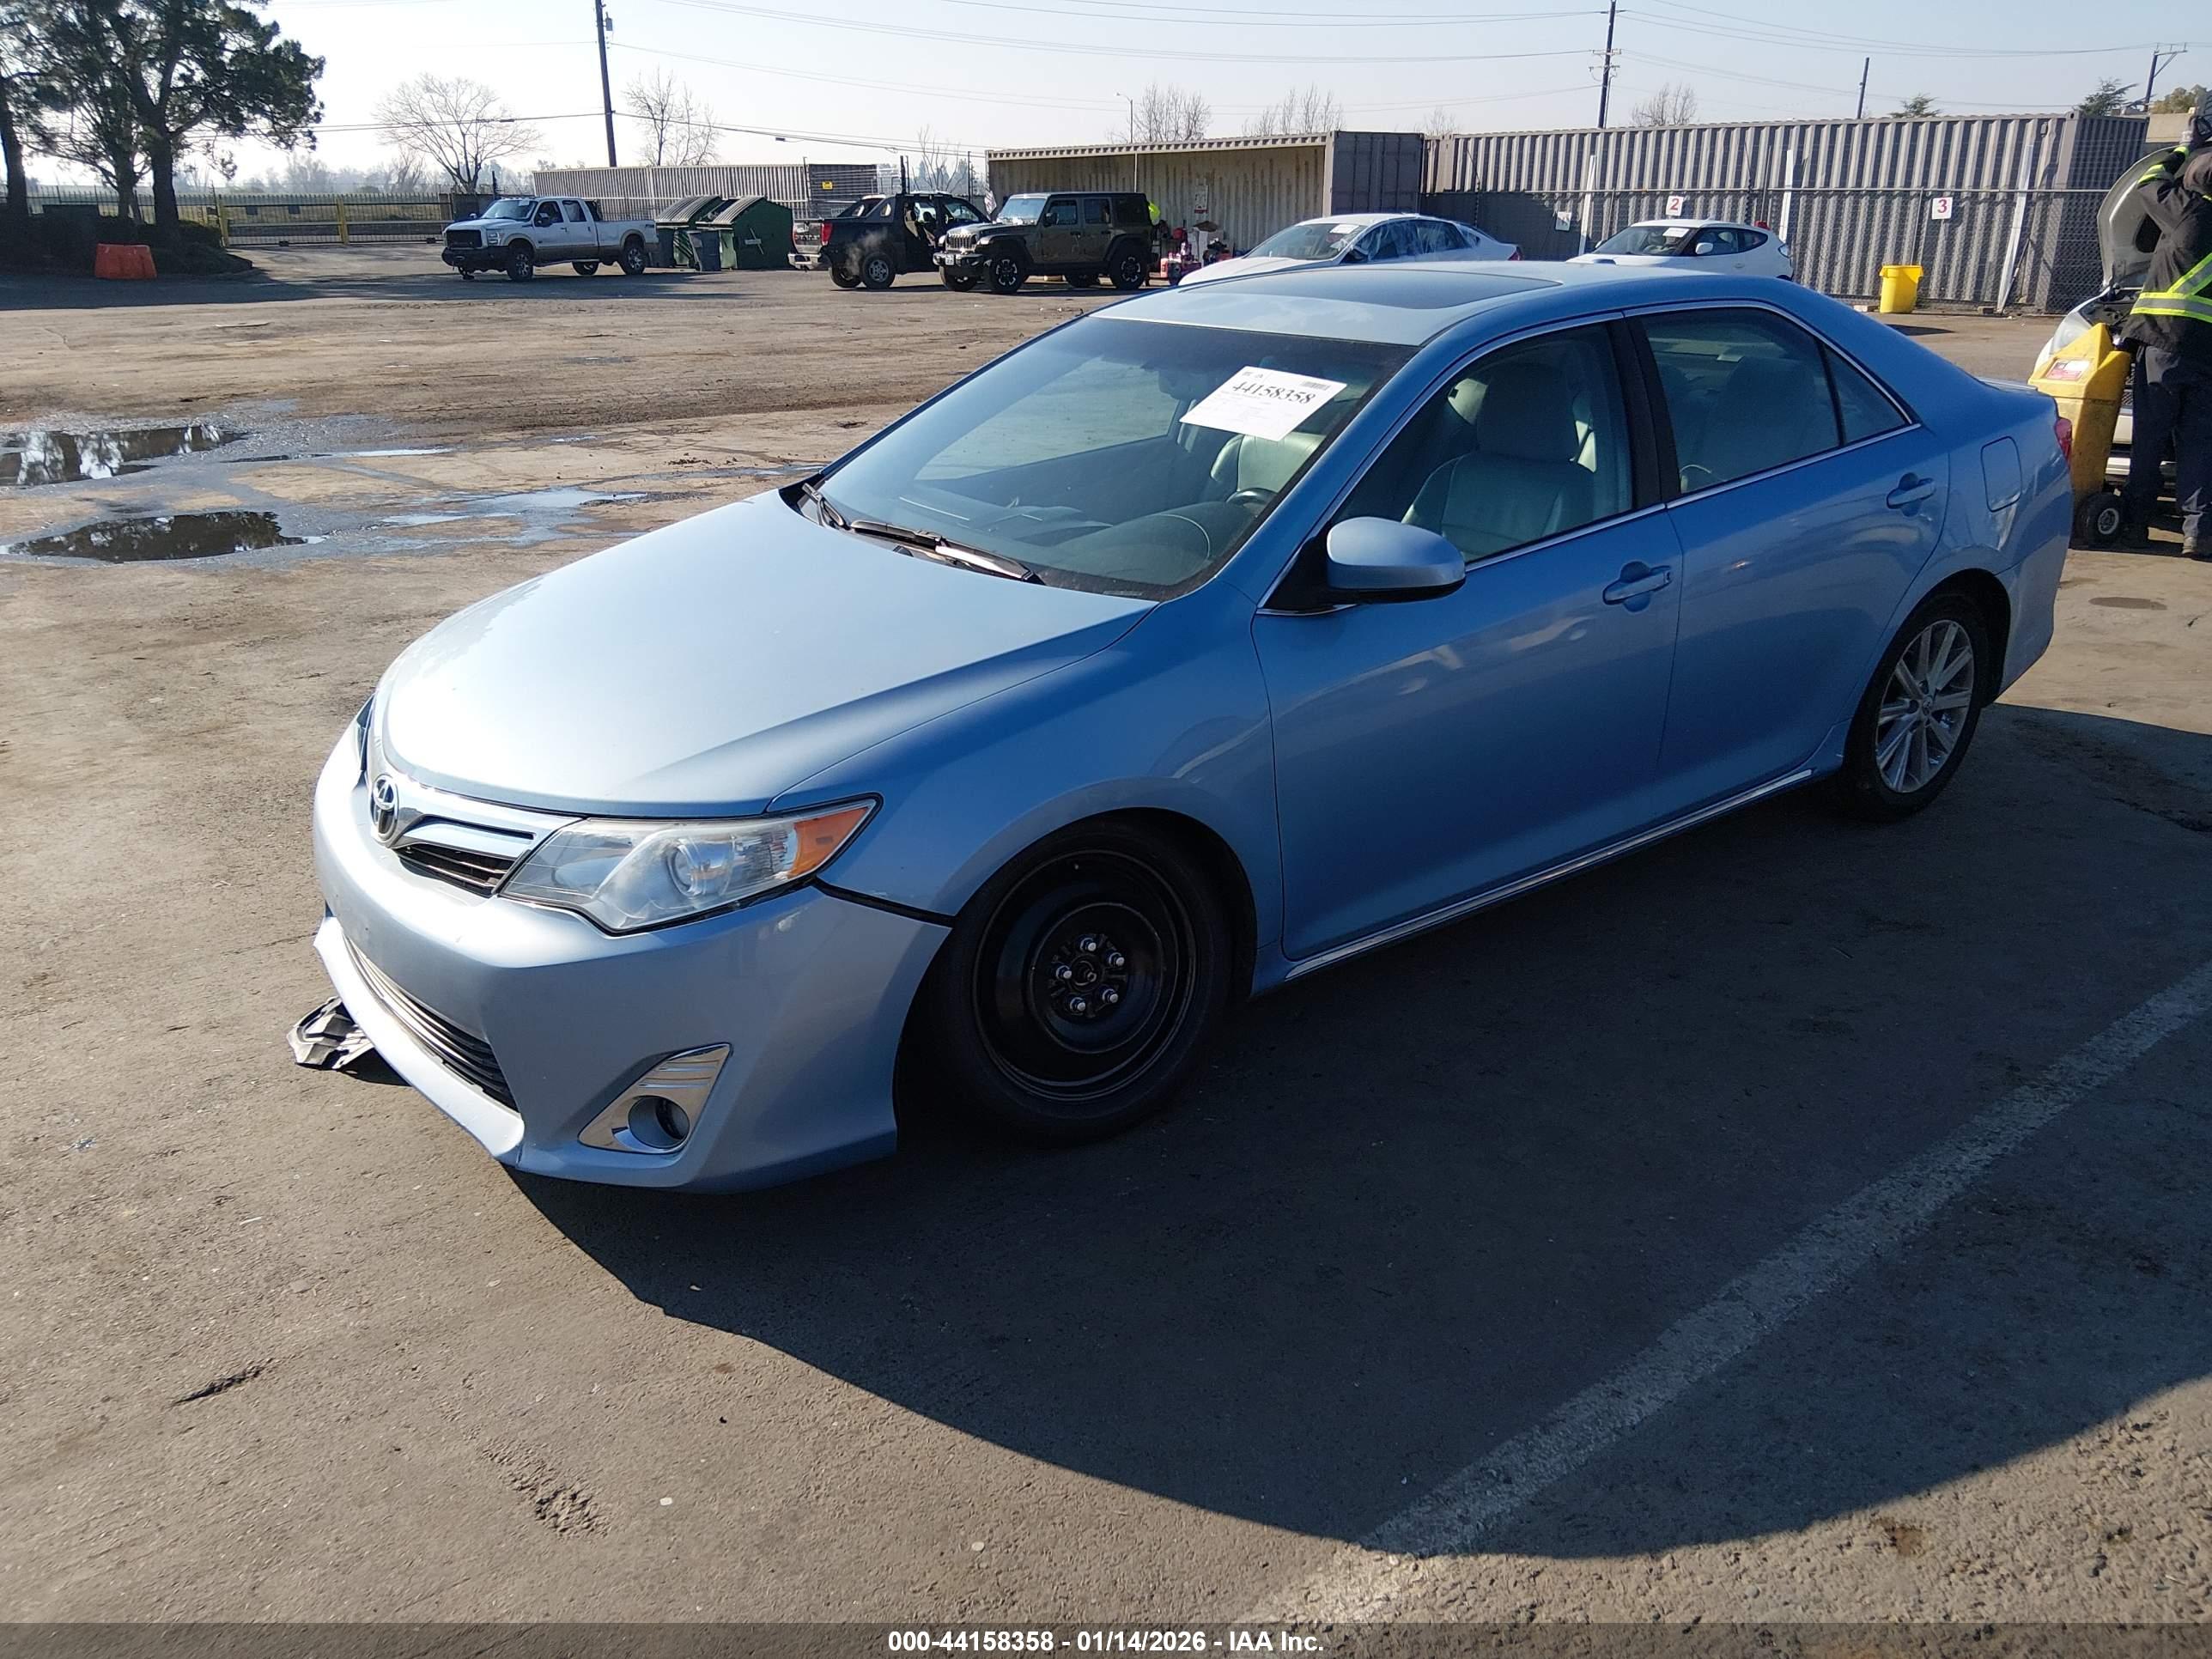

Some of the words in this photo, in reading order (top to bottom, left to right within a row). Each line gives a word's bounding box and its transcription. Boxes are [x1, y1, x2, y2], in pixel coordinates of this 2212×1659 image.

[1670, 198, 1680, 210] 2
[1937, 199, 1948, 213] 3
[1232, 381, 1316, 404] 44158358
